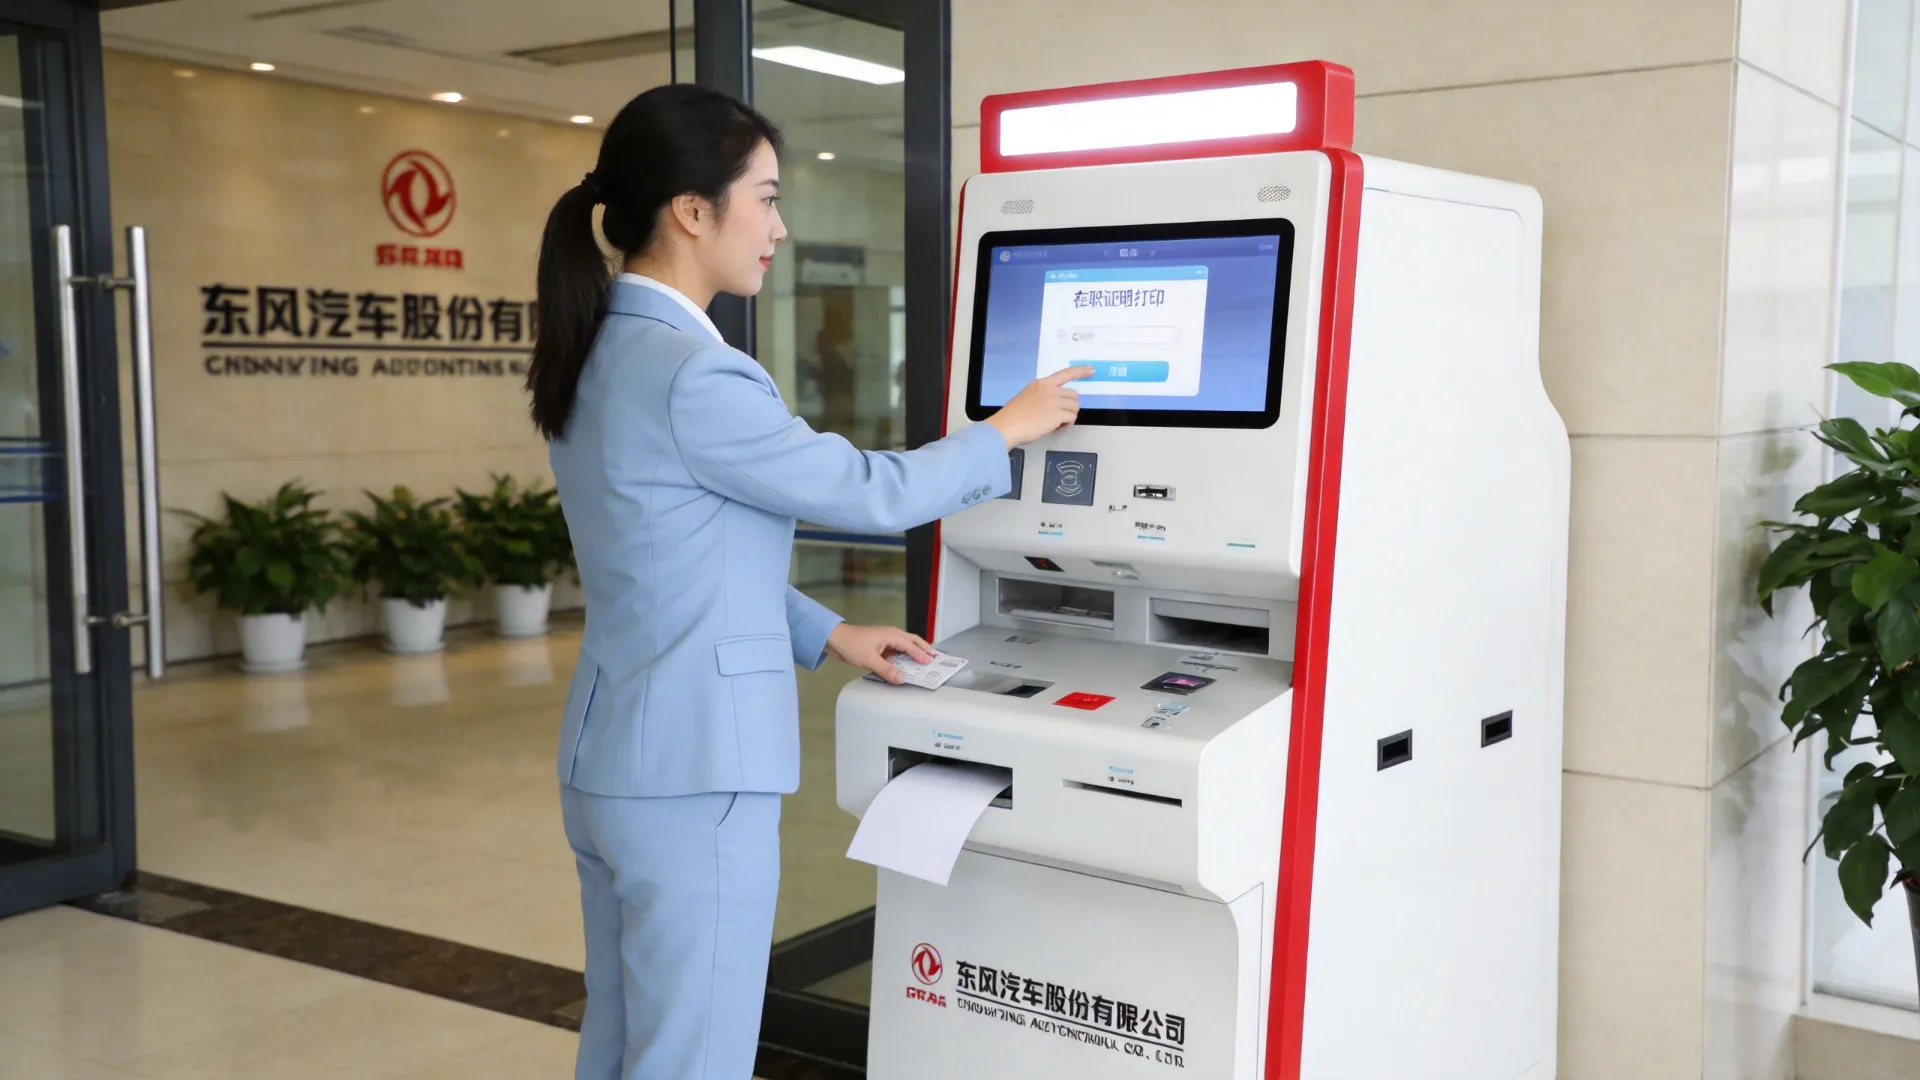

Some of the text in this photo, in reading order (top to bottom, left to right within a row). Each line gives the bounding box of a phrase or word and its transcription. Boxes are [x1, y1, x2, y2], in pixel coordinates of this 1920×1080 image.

[200, 283, 539, 342] 东风汽车股份有
[1074, 289, 1165, 308] 在职证明打印
[955, 960, 1186, 1045] 东风汽车股份有限公司
